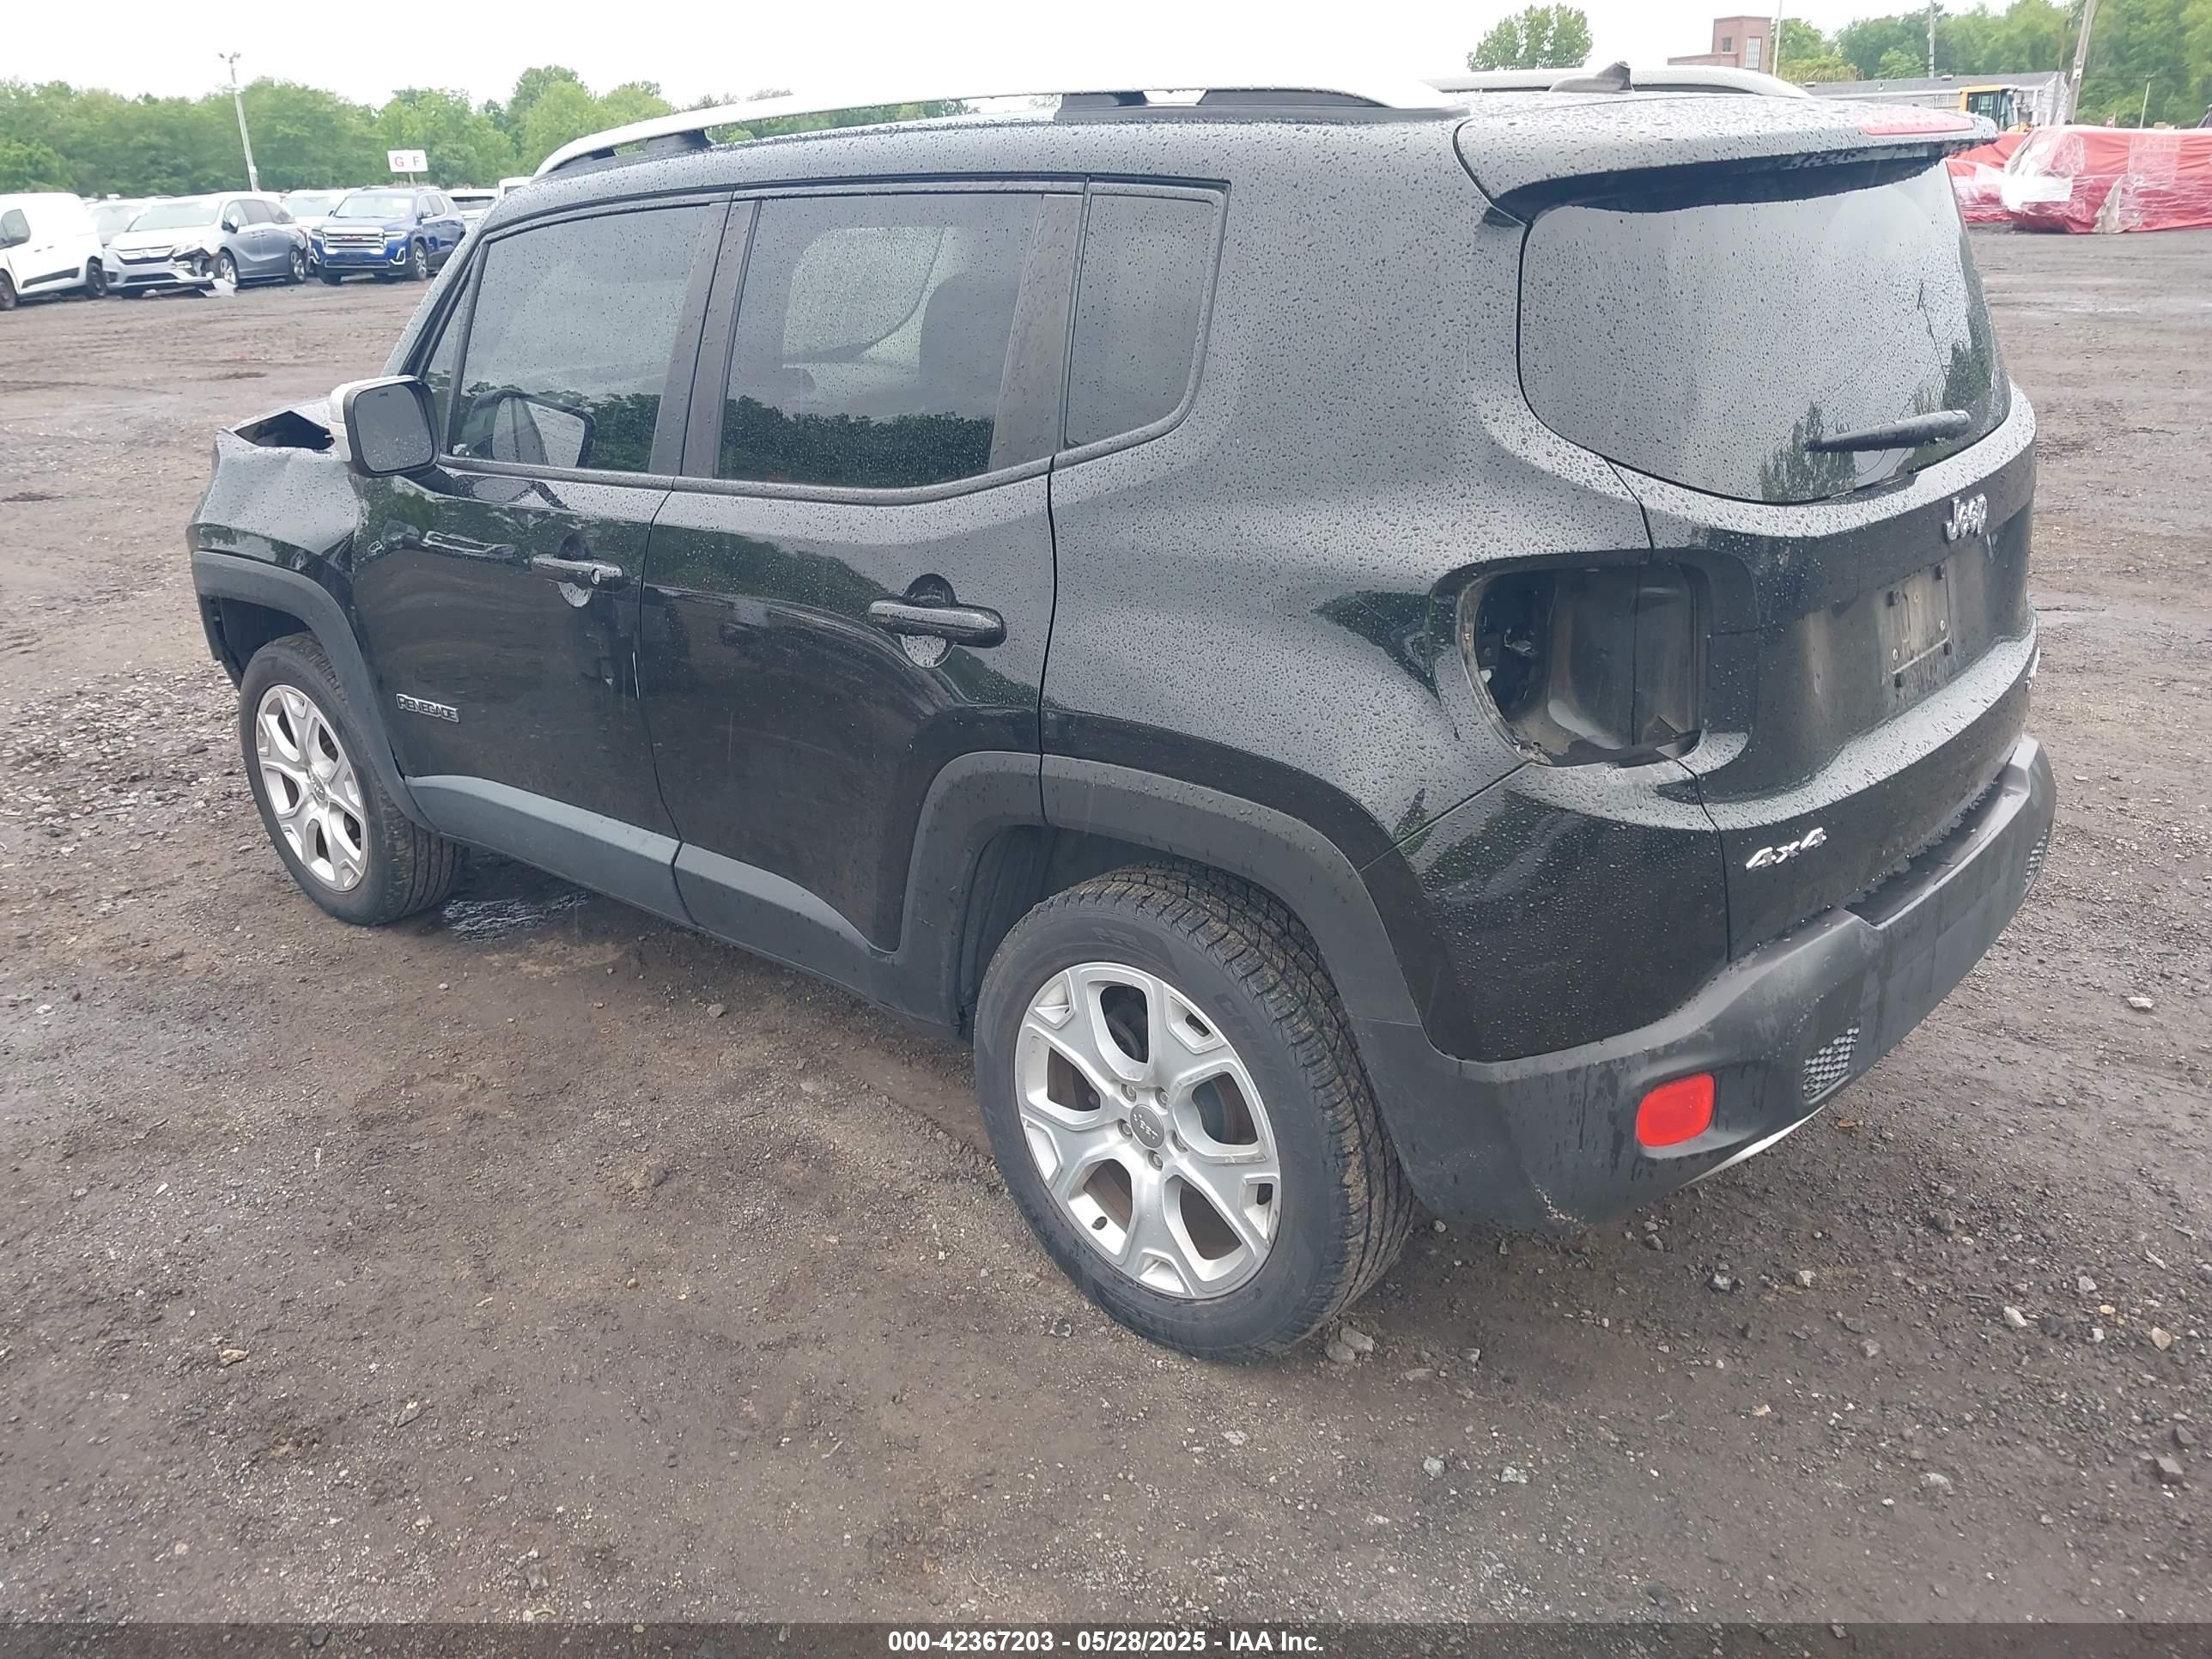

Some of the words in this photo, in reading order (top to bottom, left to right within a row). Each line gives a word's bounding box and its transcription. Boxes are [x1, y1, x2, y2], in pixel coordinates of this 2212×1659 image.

[394, 156, 404, 167] G
[412, 156, 420, 167] F
[396, 693, 460, 723] RENEGADE
[1746, 827, 1827, 870] 4x4
